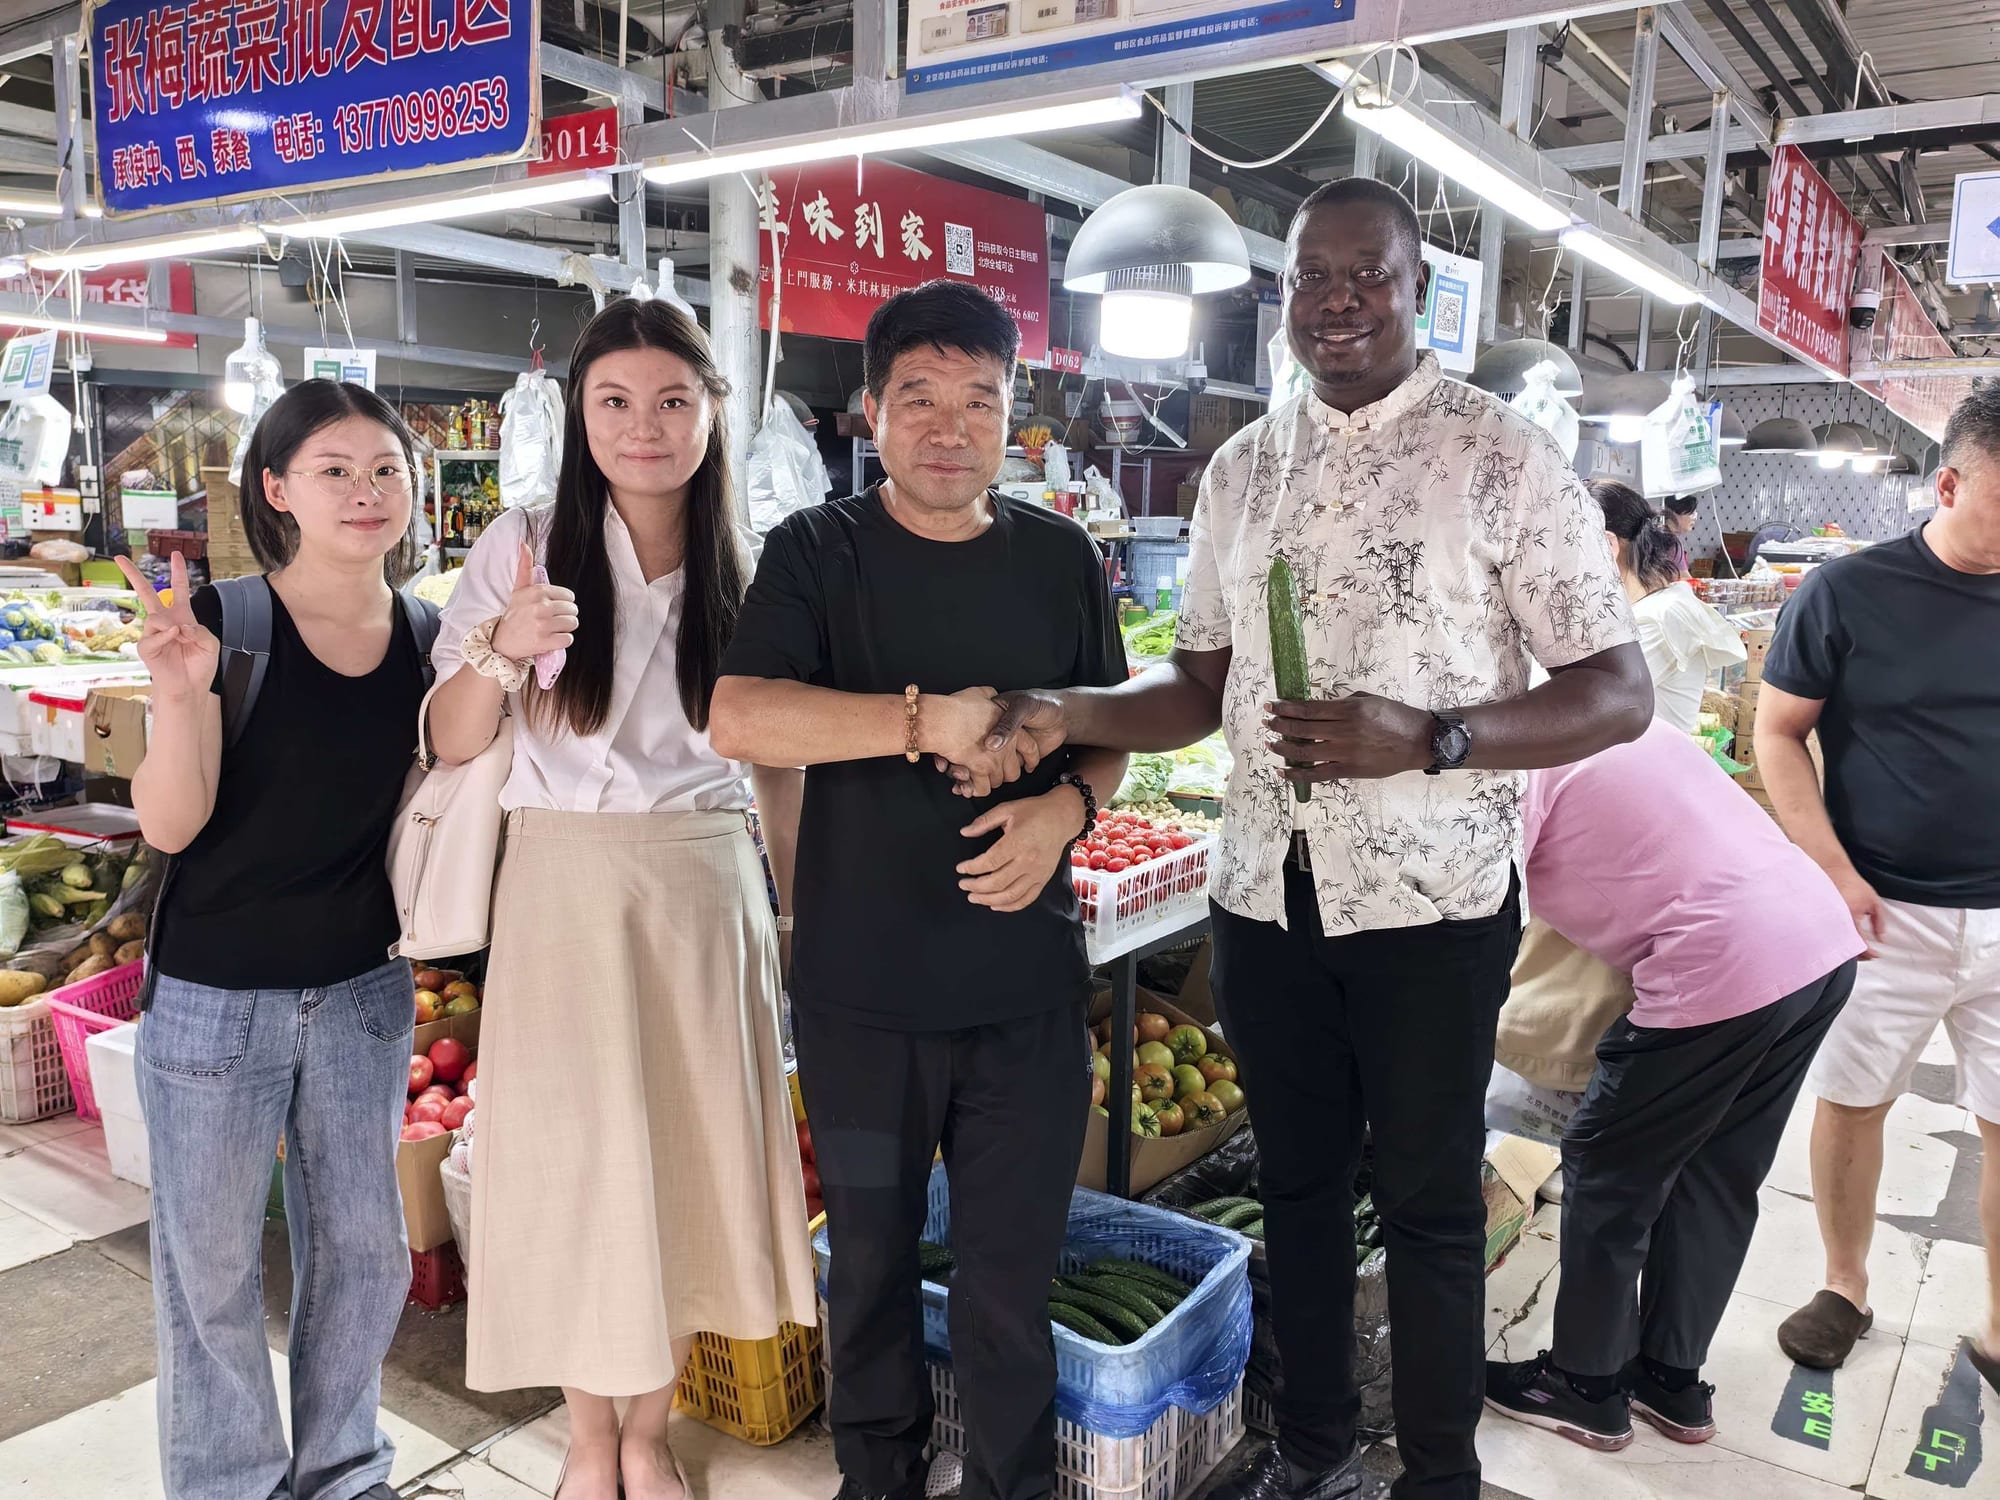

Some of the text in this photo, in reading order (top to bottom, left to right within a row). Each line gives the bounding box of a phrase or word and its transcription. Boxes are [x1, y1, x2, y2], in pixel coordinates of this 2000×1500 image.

[104, 0, 511, 122] 张梅蔬菜批发配送
[537, 122, 608, 163] E014
[1022, 310, 1039, 322] 6802
[1055, 353, 1080, 369] D062
